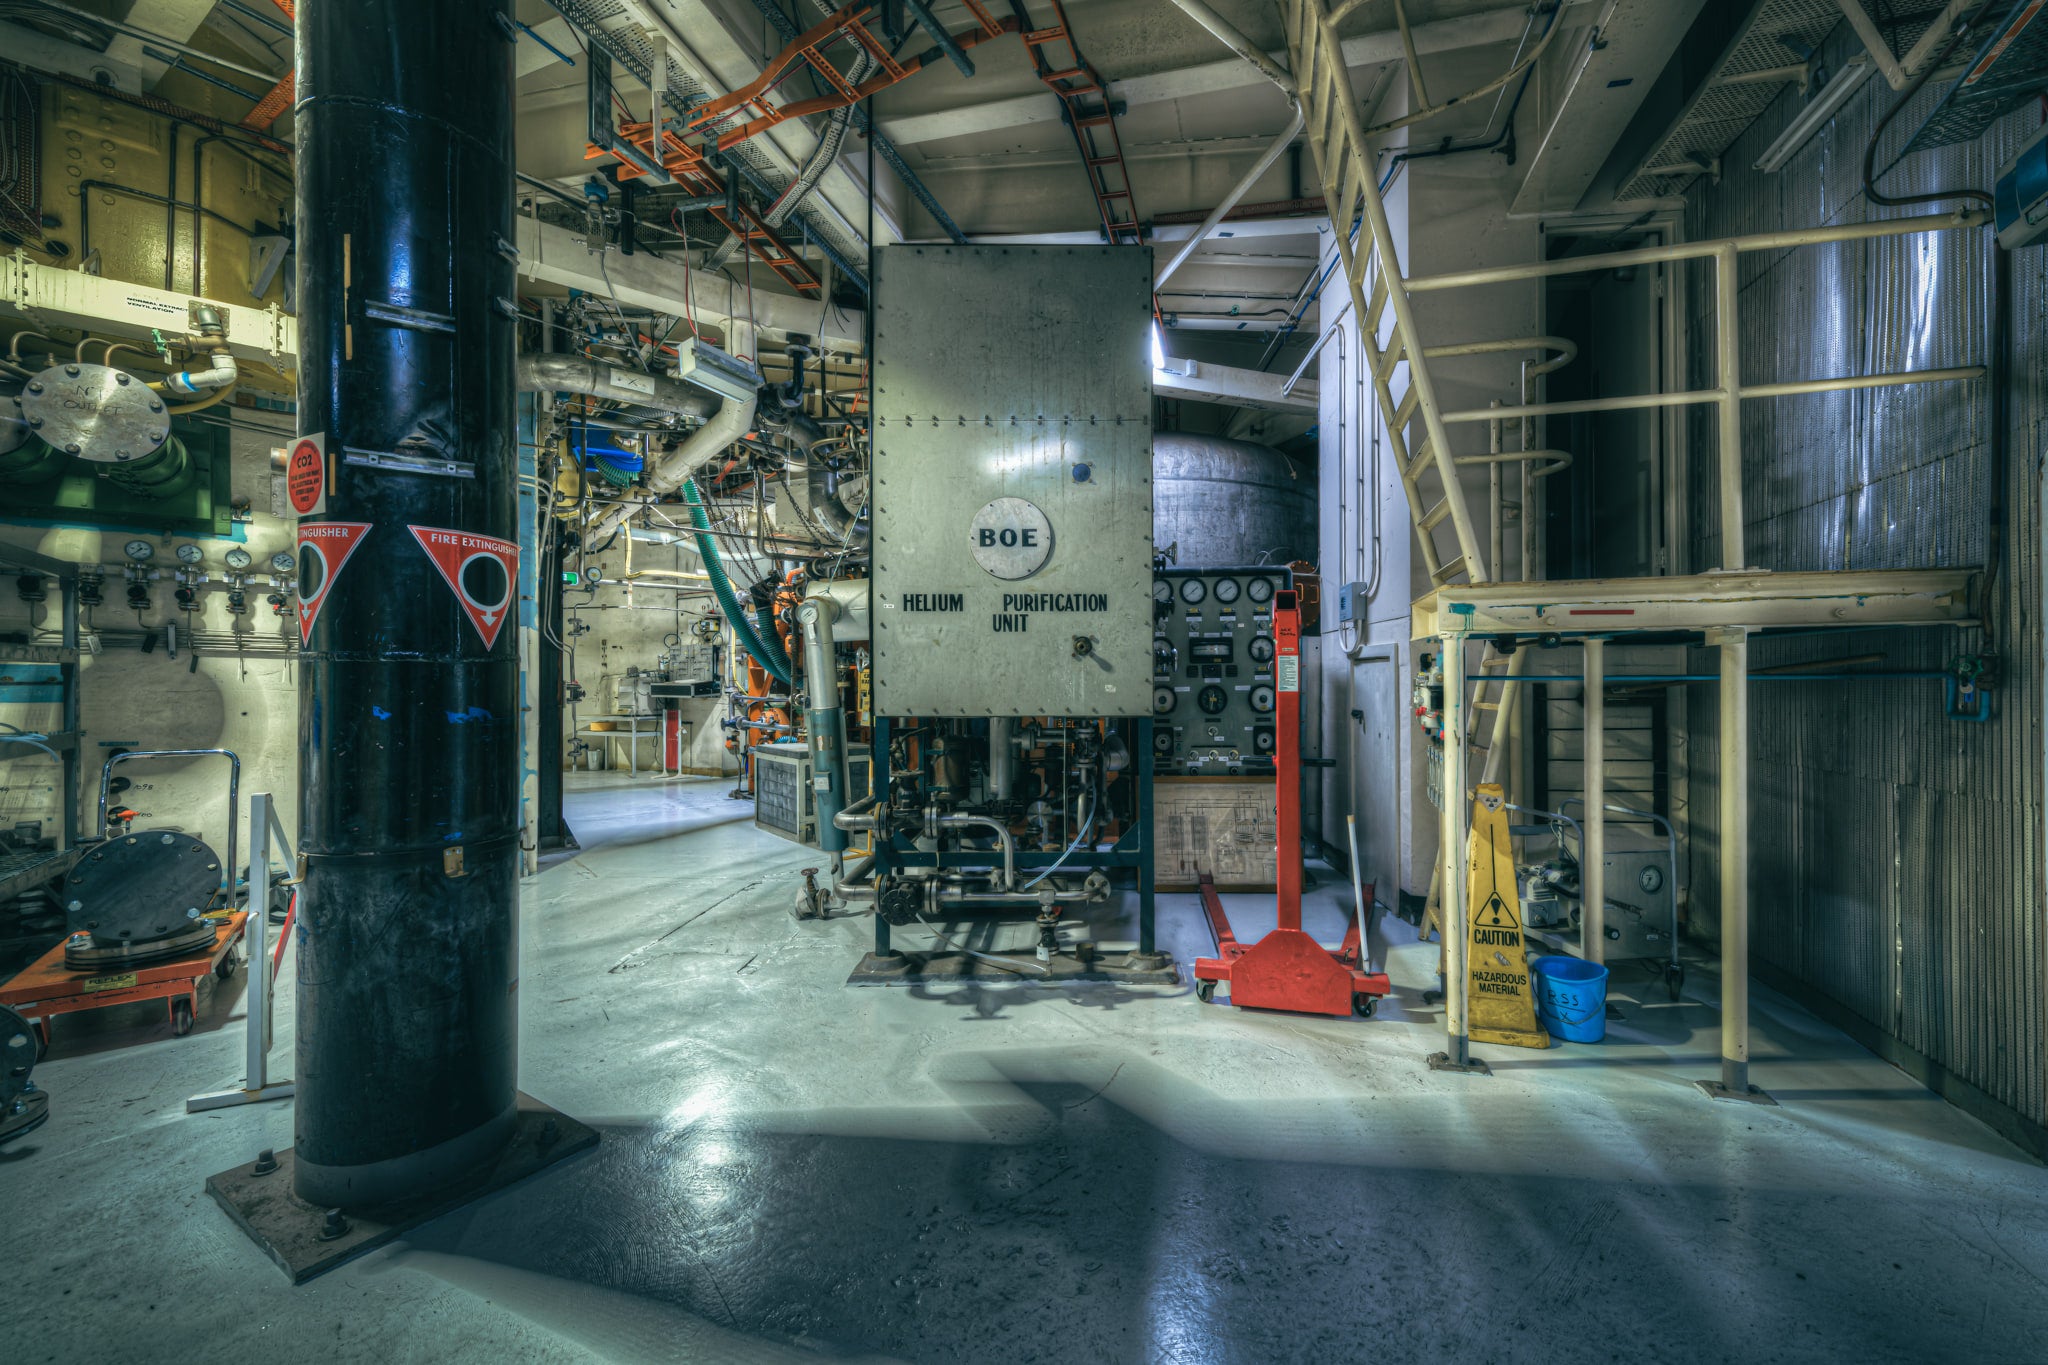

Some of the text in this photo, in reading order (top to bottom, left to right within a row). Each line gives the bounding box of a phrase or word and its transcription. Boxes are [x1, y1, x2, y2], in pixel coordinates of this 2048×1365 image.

[126, 297, 188, 312] NORMAL EXTRACT
[127, 301, 174, 314] VENTILATION
[297, 454, 313, 469] CO2
[431, 533, 458, 545] FIRE
[979, 528, 1038, 547] BOE
[903, 593, 1109, 612] HELIUM PURIFICATION
[992, 614, 1029, 633] UNIT
[1474, 929, 1520, 947] CAUTION
[1472, 971, 1527, 985] HAZARDOUS
[1479, 982, 1521, 996] MATERIAL
